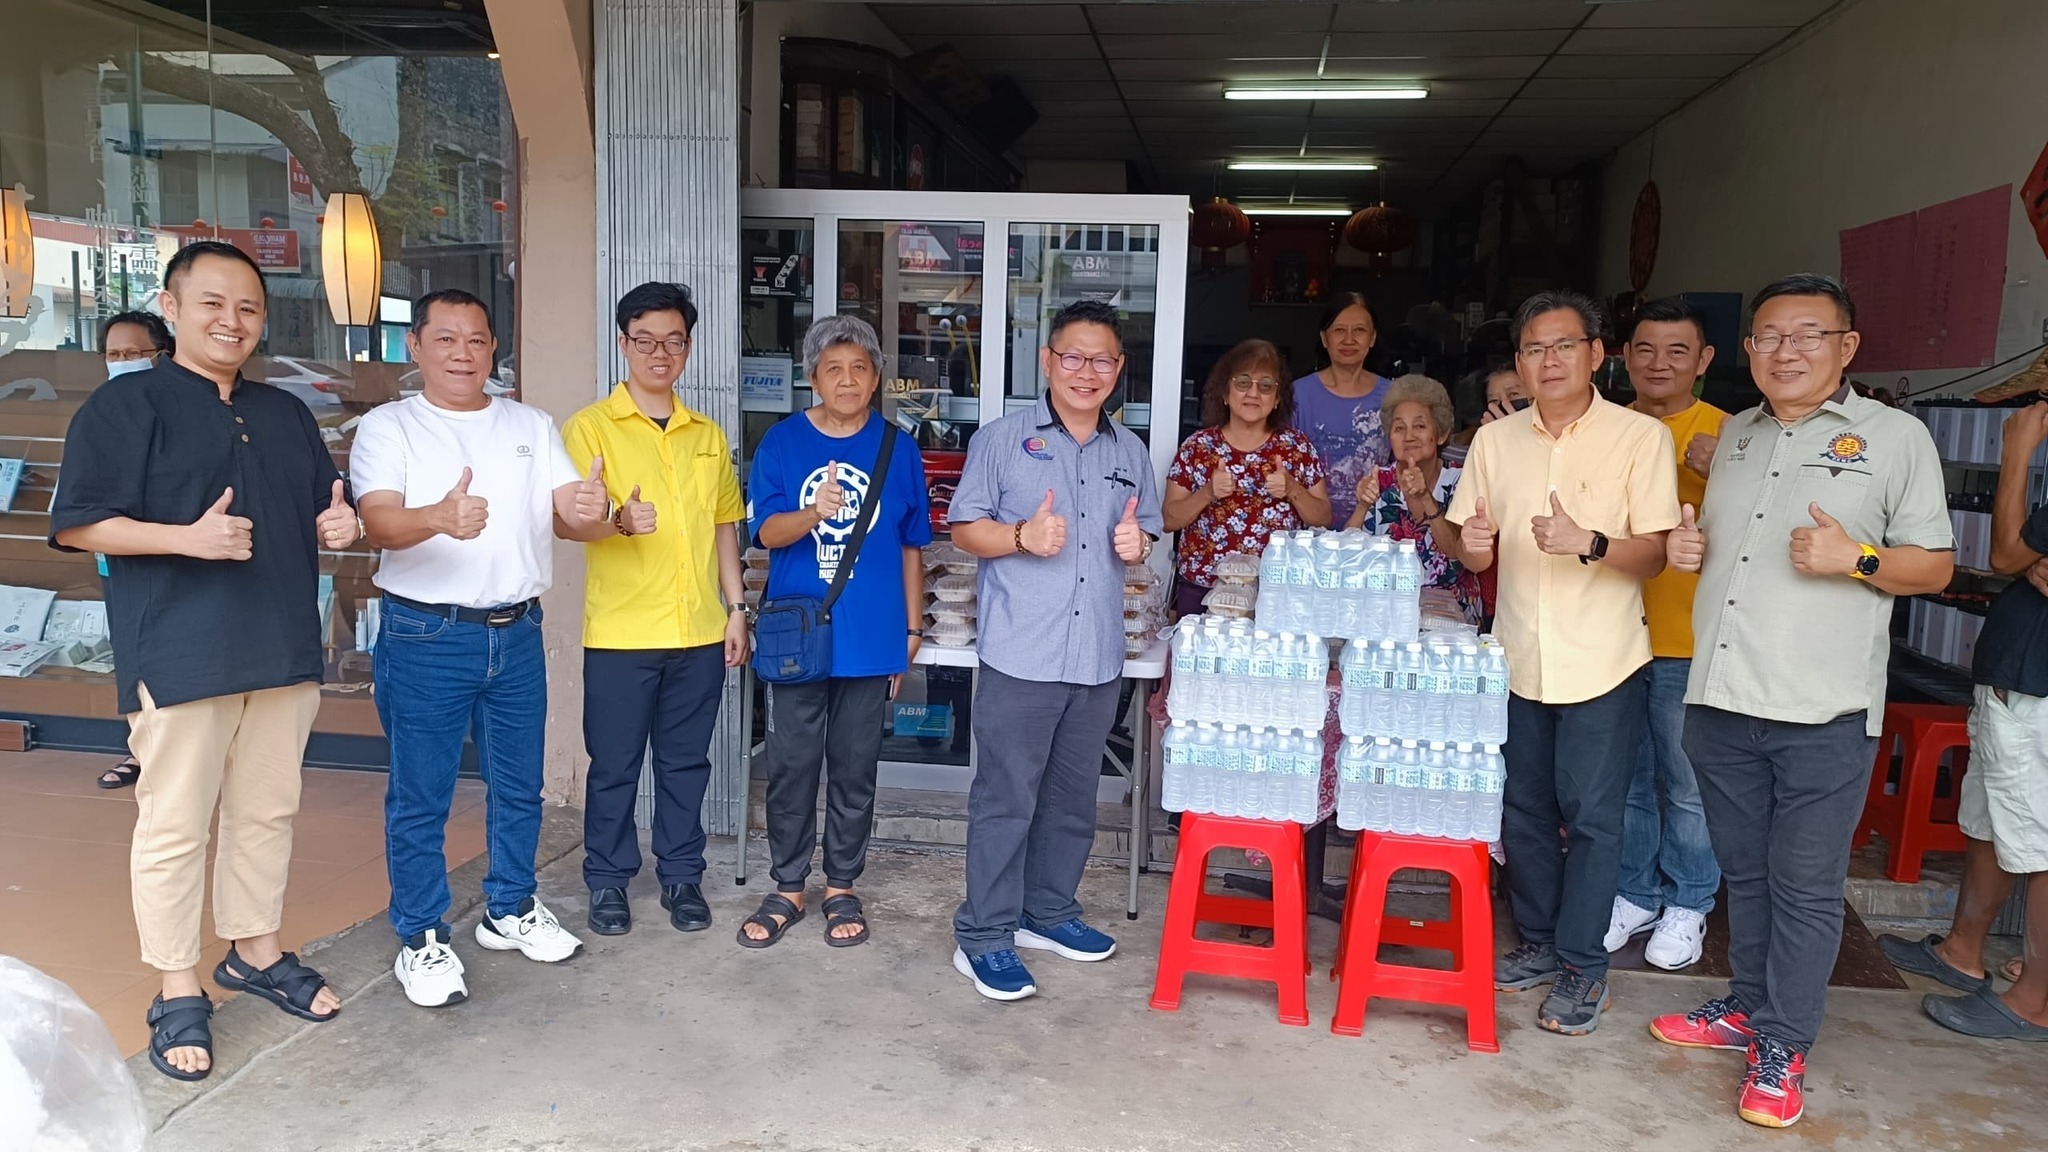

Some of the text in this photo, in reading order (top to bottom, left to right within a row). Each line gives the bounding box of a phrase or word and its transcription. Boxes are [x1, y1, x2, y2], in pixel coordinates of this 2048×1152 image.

[1072, 256, 1110, 270] ABM
[743, 376, 784, 386] FUJIYA
[884, 378, 920, 391] ABM
[898, 707, 926, 716] ABM
